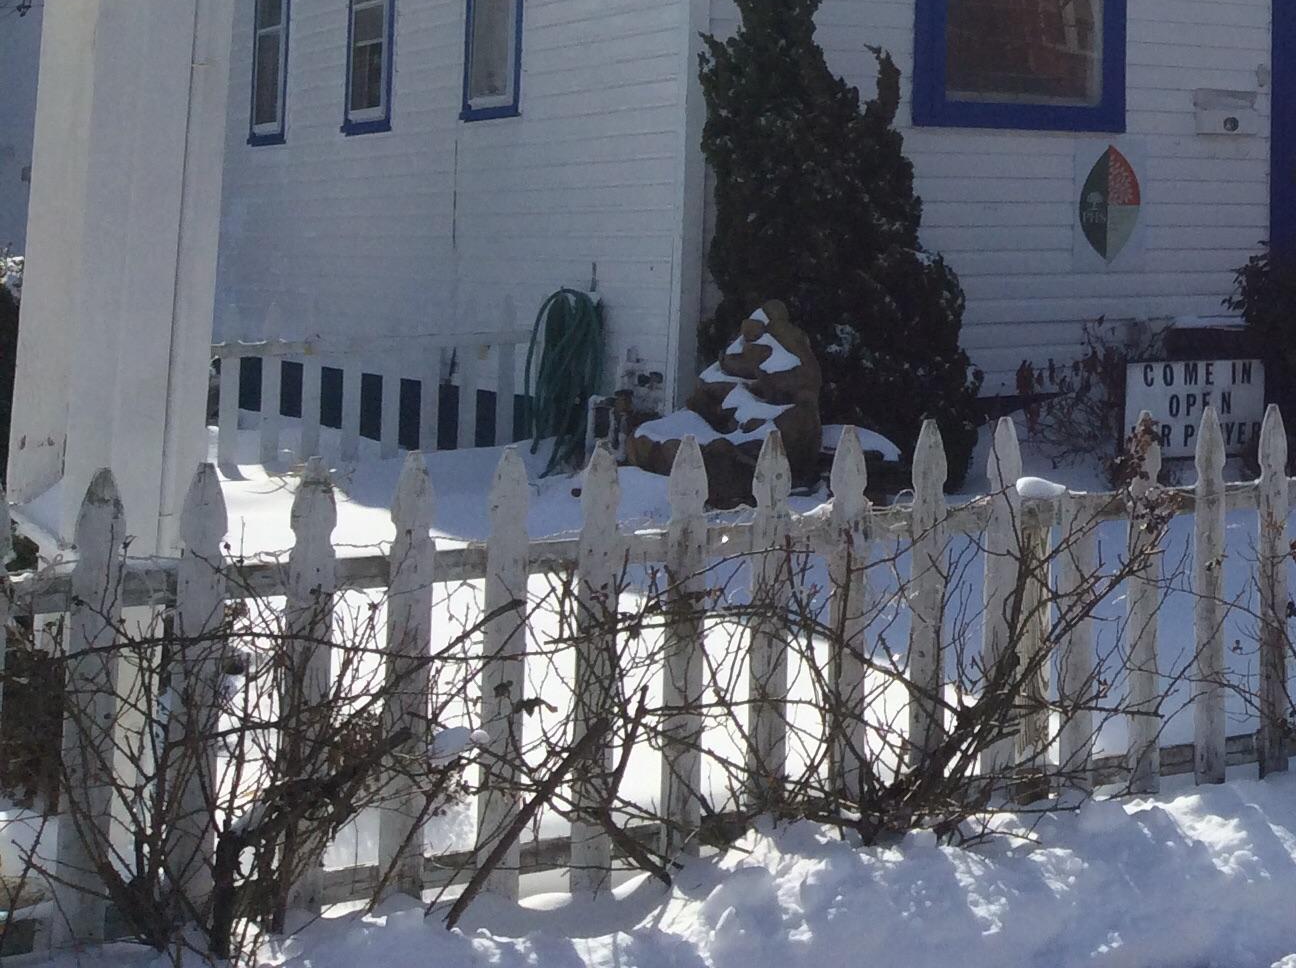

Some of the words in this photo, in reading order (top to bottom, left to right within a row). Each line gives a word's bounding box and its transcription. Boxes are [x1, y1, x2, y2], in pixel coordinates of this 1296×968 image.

[1143, 362, 1213, 387] COME
[1231, 362, 1252, 385] IN
[1169, 392, 1231, 417] OPEN
[1183, 421, 1262, 447] PYER
